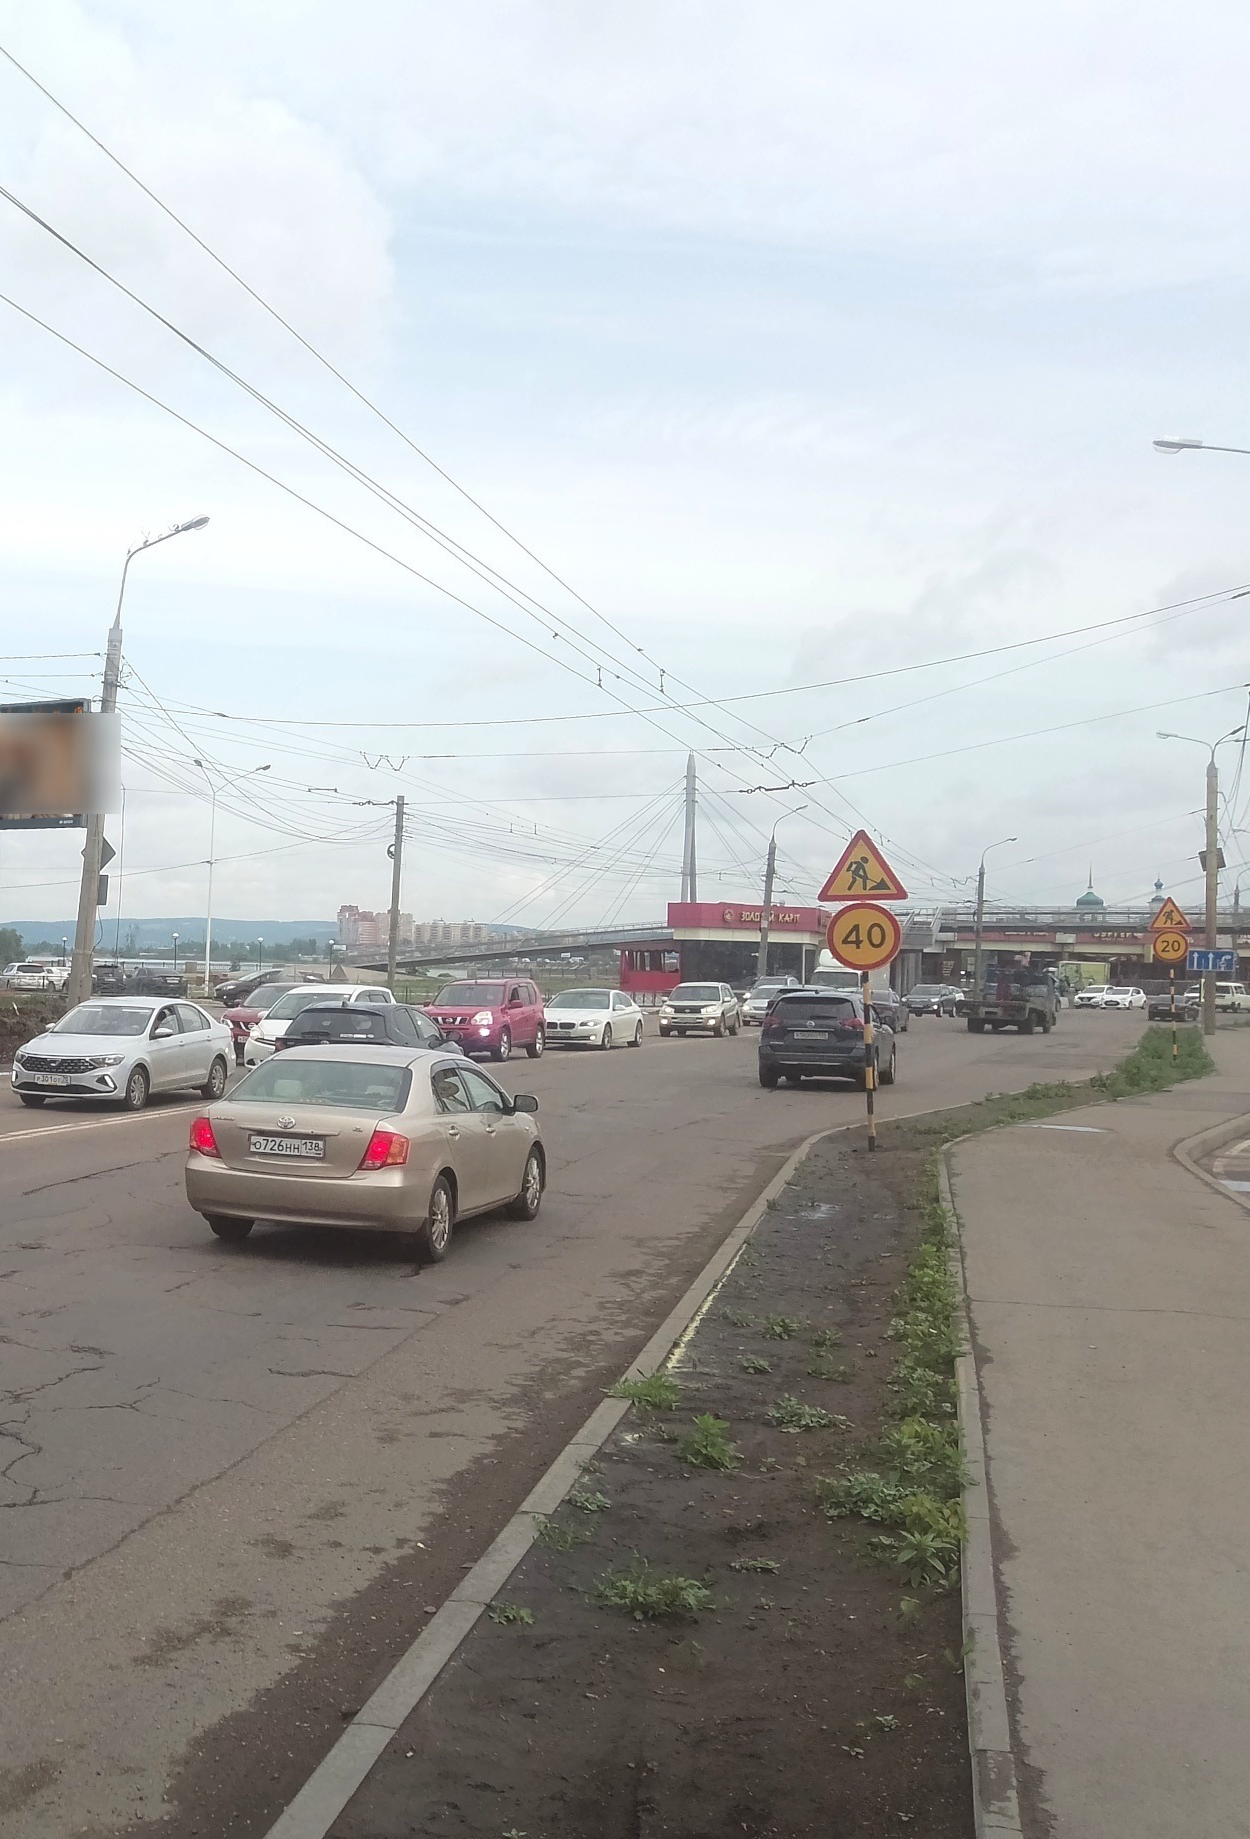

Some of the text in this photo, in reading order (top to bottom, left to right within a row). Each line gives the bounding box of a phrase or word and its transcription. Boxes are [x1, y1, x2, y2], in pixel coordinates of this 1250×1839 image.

[741, 910, 774, 921] ЗОЛОЙ
[841, 922, 886, 949] 40
[1161, 940, 1180, 952] 20
[254, 1138, 320, 1153] О726НН 138
